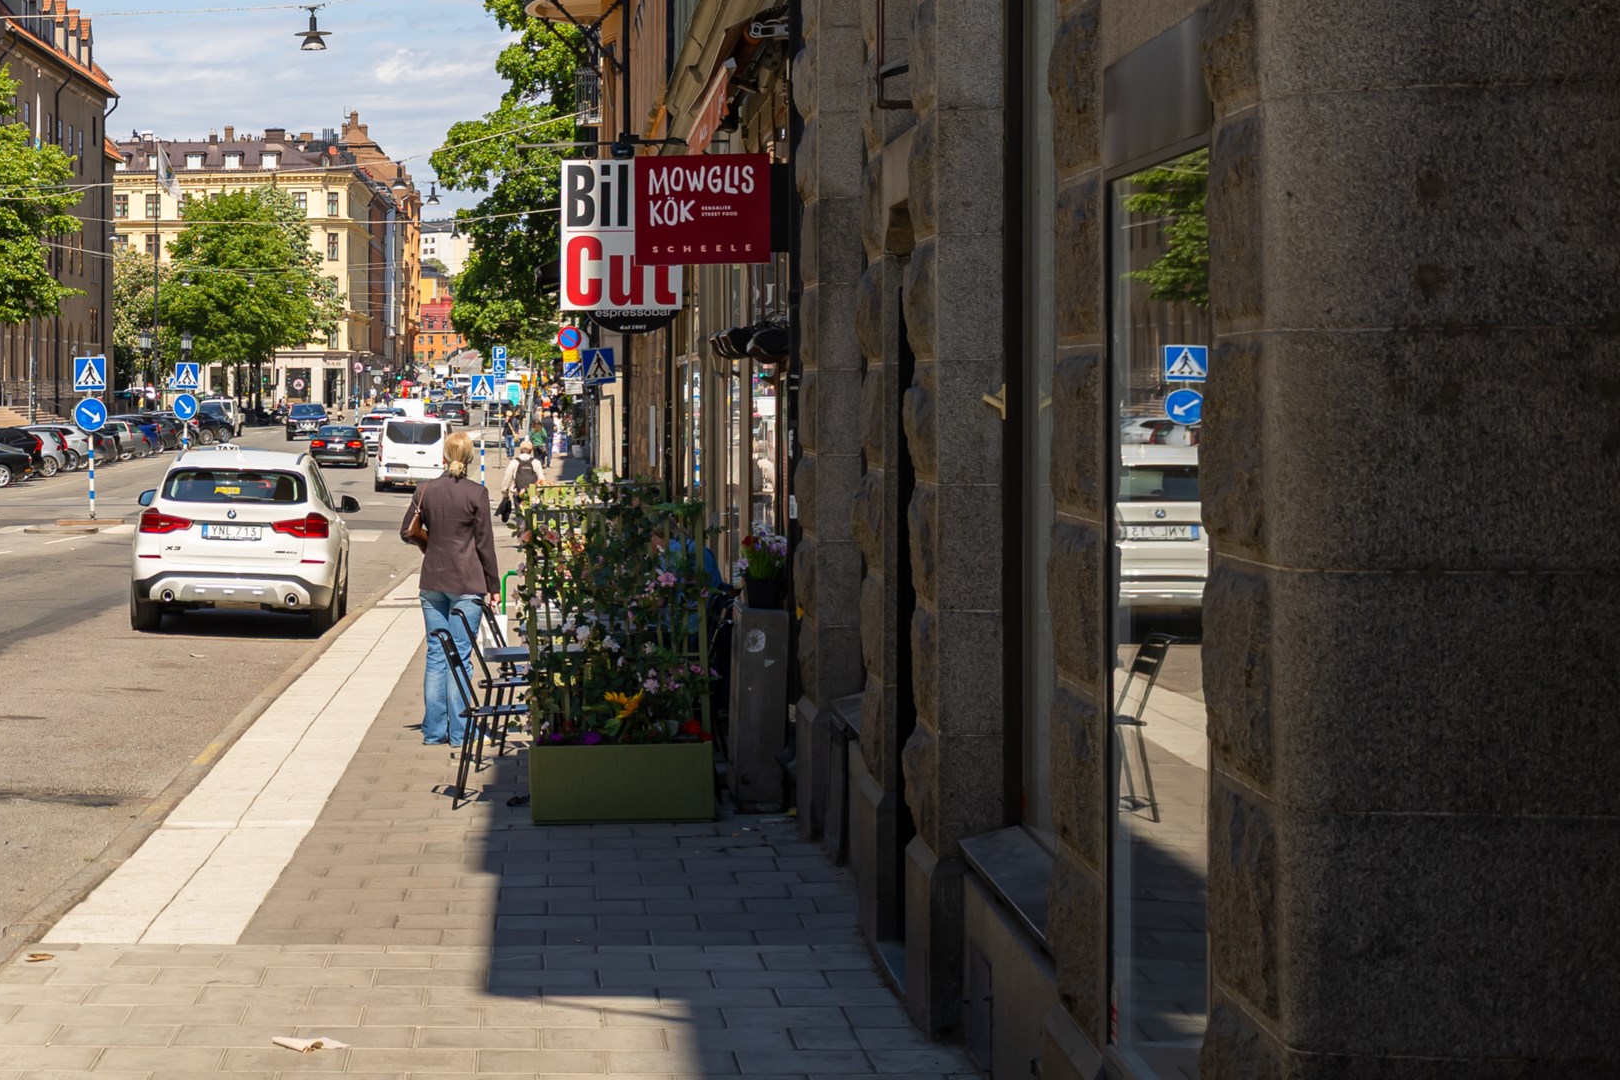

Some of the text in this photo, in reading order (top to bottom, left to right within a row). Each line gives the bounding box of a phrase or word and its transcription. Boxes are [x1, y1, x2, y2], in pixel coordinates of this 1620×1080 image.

[649, 165, 755, 195] MOWGLIS
[649, 196, 695, 227] KÖK
[652, 243, 752, 253] SCHEELE
[567, 236, 677, 306] Cut
[496, 348, 504, 358] P
[212, 526, 257, 536] YNL 713
